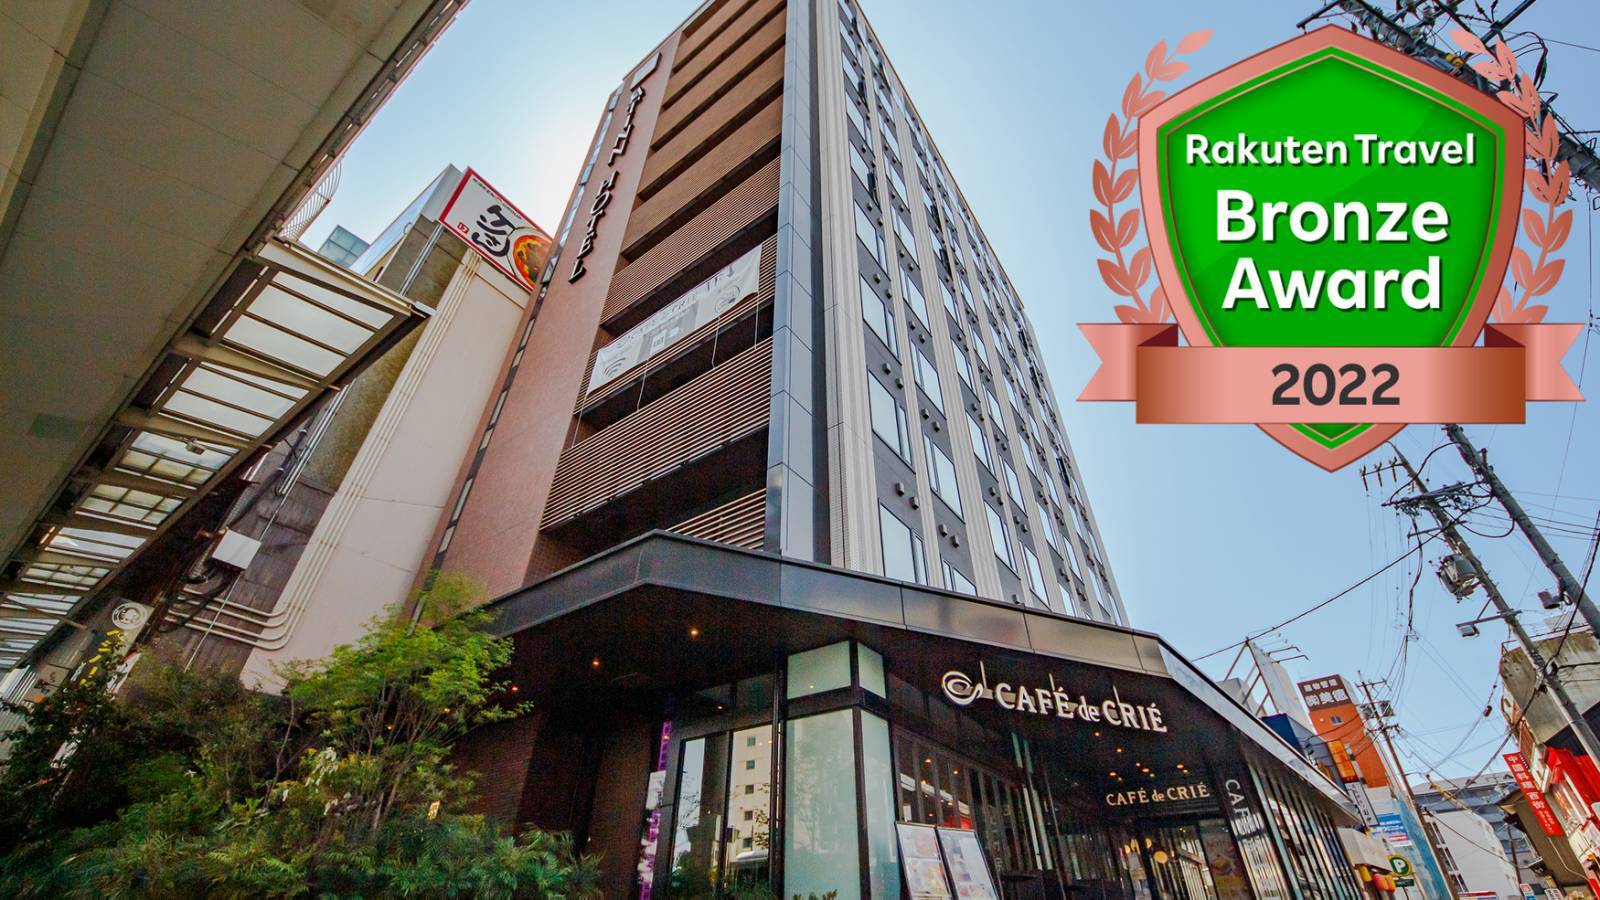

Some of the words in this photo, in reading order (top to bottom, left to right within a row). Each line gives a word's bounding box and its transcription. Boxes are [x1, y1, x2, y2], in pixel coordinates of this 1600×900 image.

[568, 171, 618, 283] HOTEL
[995, 682, 1075, 719] CAFÉ
[1078, 695, 1101, 722] de
[1102, 700, 1168, 733] CRIÉ
[1106, 787, 1150, 806] CAFÉ
[1152, 789, 1166, 801] de
[1167, 781, 1211, 801] CRIÉ
